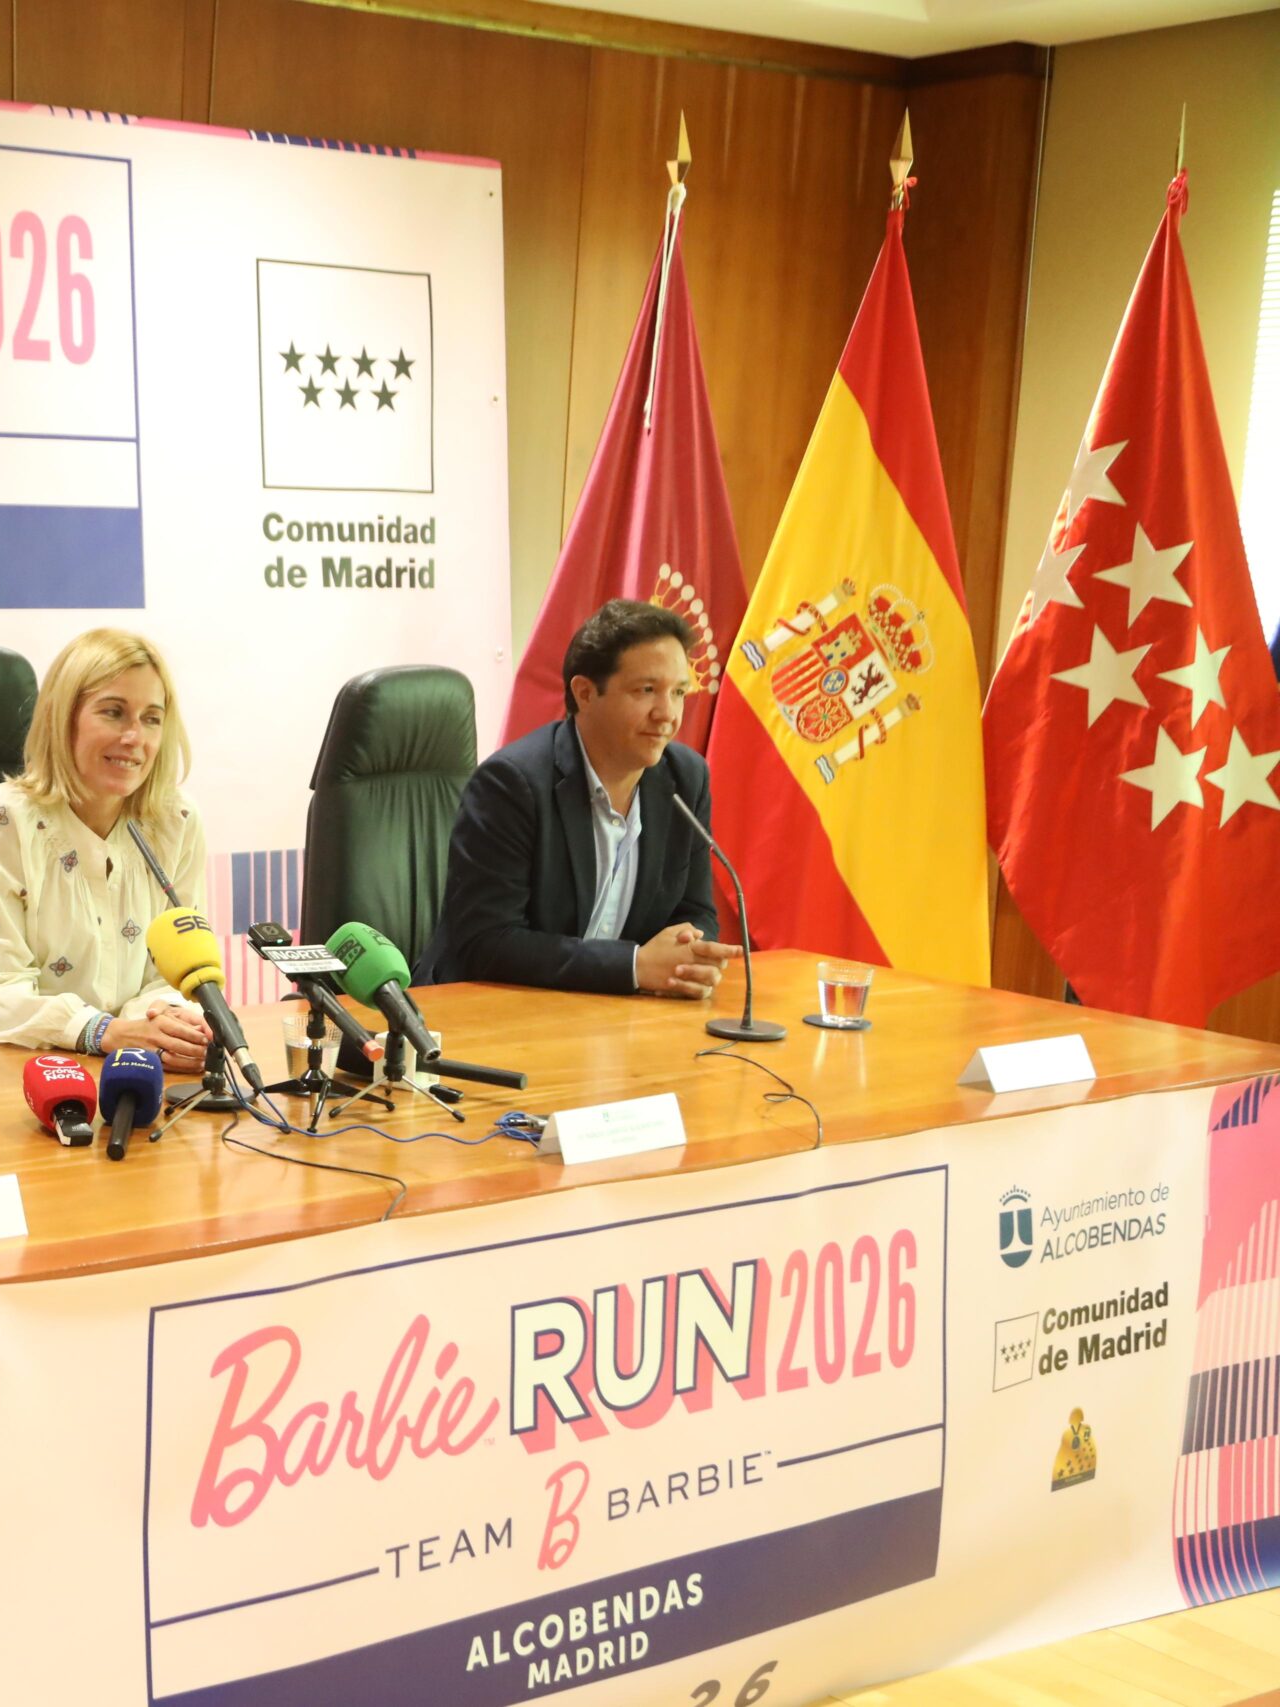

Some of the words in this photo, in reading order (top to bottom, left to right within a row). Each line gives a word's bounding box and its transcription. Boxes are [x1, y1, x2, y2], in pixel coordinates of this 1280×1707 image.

[262, 512, 437, 546] Comunidad
[263, 555, 308, 589] de
[321, 555, 436, 589] Madrid
[1040, 1188, 1145, 1231] Ayuntamiento
[1150, 1182, 1170, 1204] de
[1039, 1212, 1166, 1264] ALCOBENDAS
[1042, 1281, 1169, 1335] Comunidad
[1038, 1343, 1069, 1376] de
[1077, 1319, 1168, 1366] Madrid
[190, 1313, 501, 1528] Barbie
[509, 1258, 778, 1454] RUN
[775, 1228, 918, 1393] 2026
[385, 1517, 513, 1578] TEAM
[537, 1460, 590, 1571] B
[607, 1452, 763, 1521] BARBIE
[466, 1573, 704, 1671] ALCOBENDAS
[527, 1631, 649, 1688] MADRID
